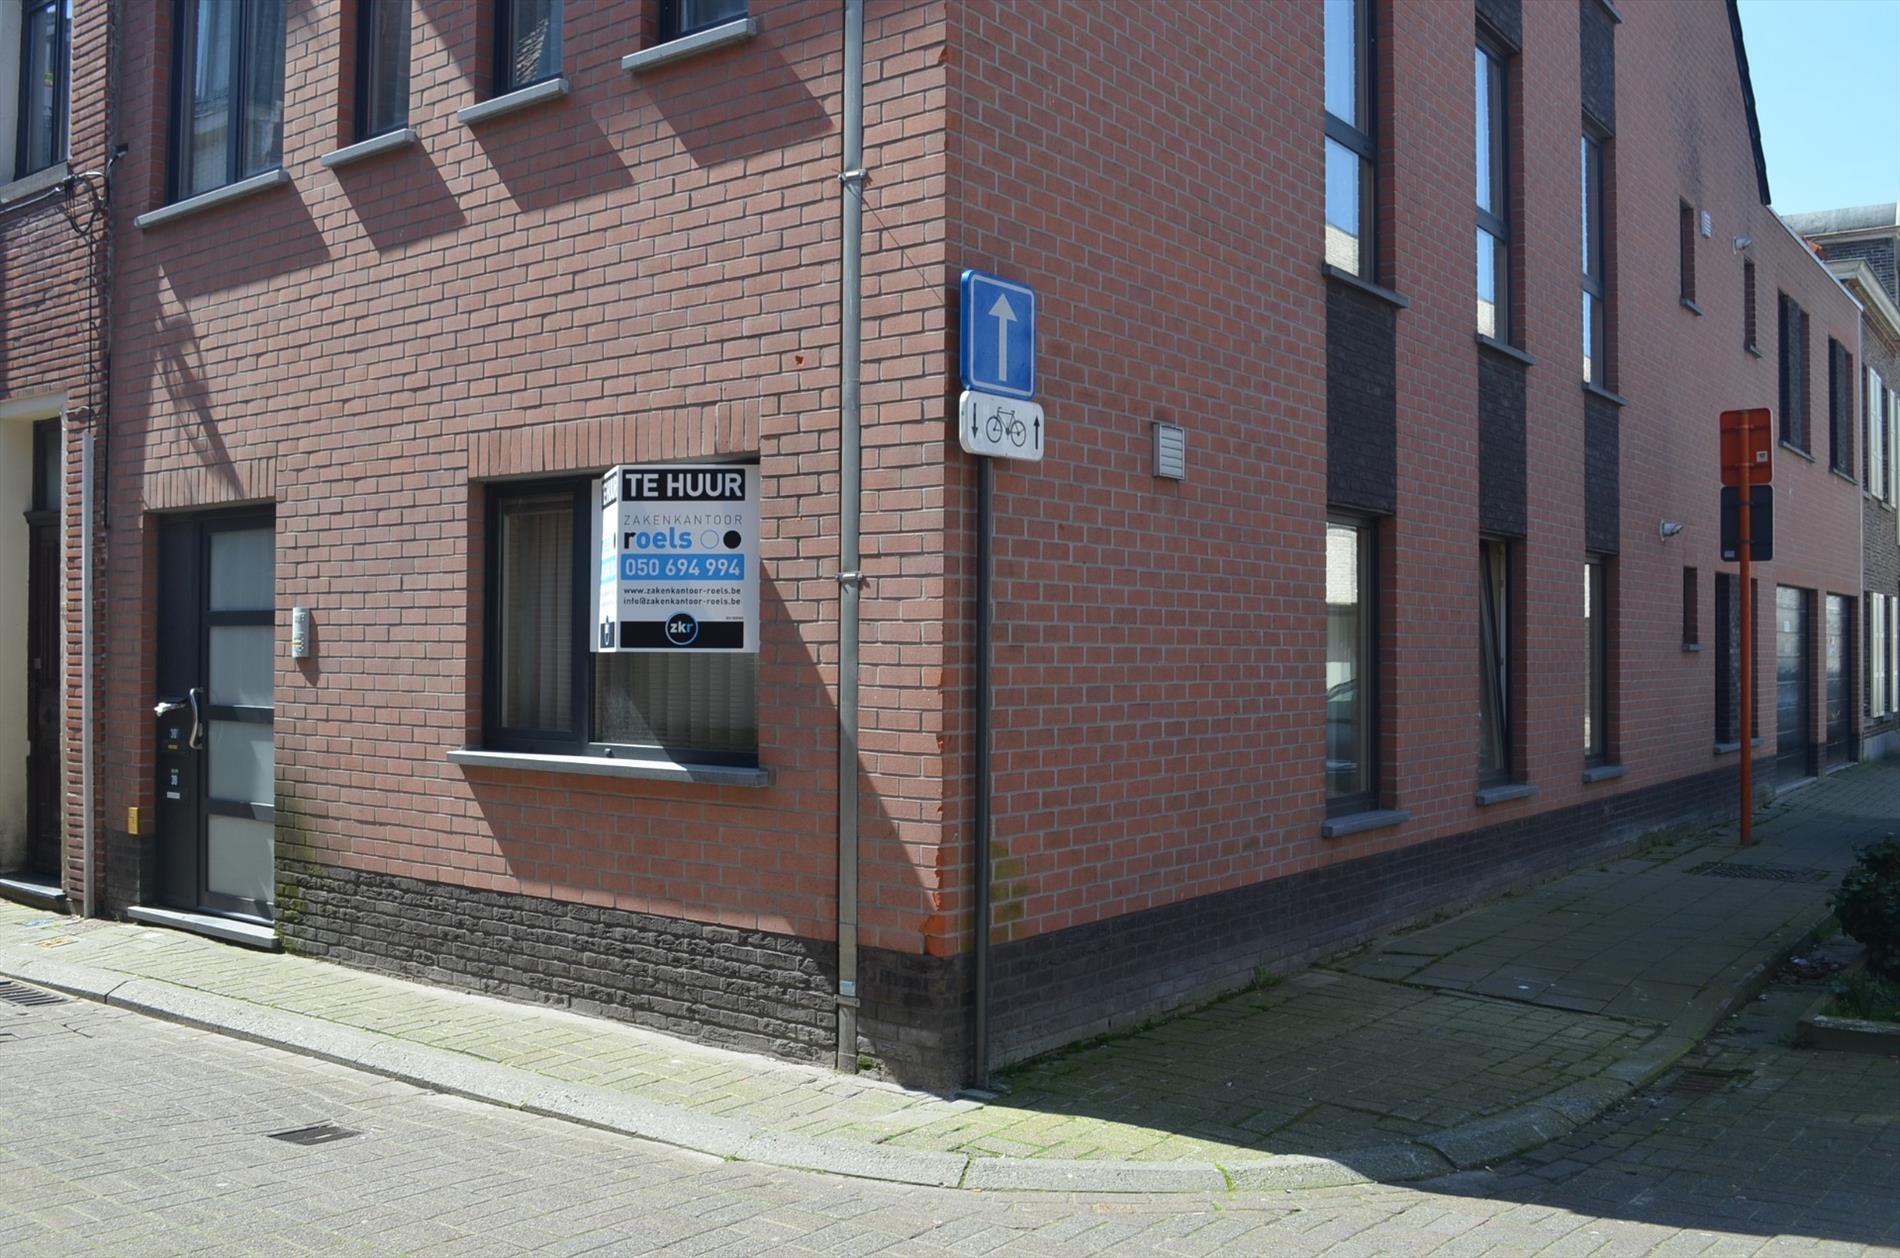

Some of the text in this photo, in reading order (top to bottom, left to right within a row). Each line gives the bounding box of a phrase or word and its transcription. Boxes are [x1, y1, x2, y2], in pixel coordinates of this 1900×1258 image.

[626, 473, 660, 497] TE
[667, 473, 743, 497] HUUR
[624, 514, 743, 525] ZAKENKANTOOR
[624, 527, 693, 549] roels
[625, 559, 740, 576] 050 694 994
[624, 587, 741, 595] www.zakenkantoor-roels.be
[624, 597, 741, 605] info@zakenkantoor-roels.be
[670, 621, 693, 633] zkr
